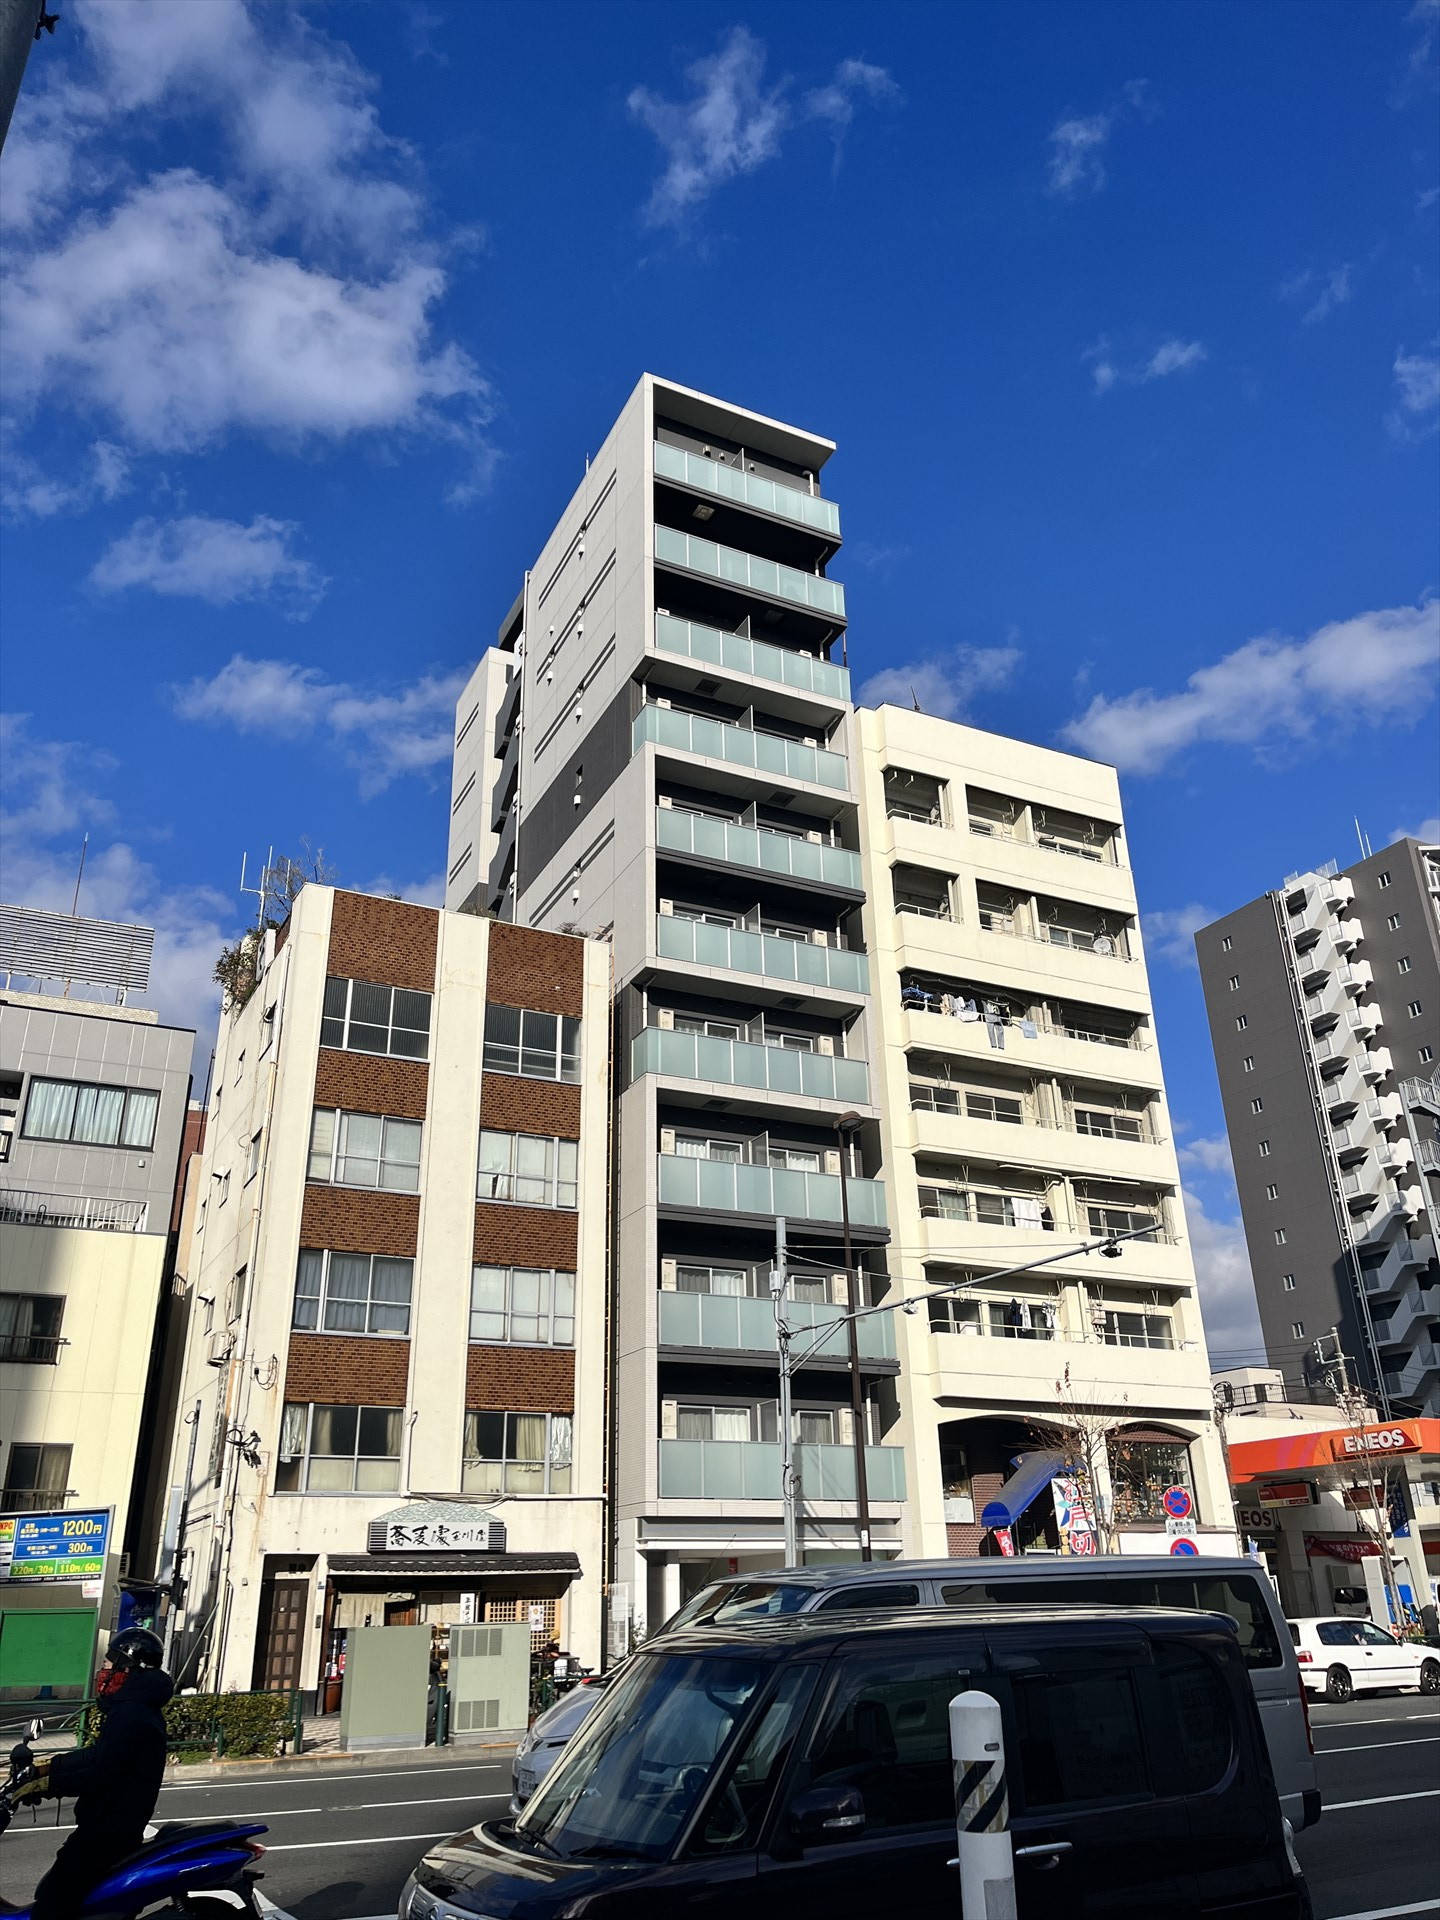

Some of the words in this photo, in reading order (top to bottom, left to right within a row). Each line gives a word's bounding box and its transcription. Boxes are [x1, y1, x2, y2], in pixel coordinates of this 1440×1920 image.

[1343, 1428, 1405, 1453] ENEOS
[62, 1519, 103, 1536] 1200円
[67, 1542, 93, 1553] 300円
